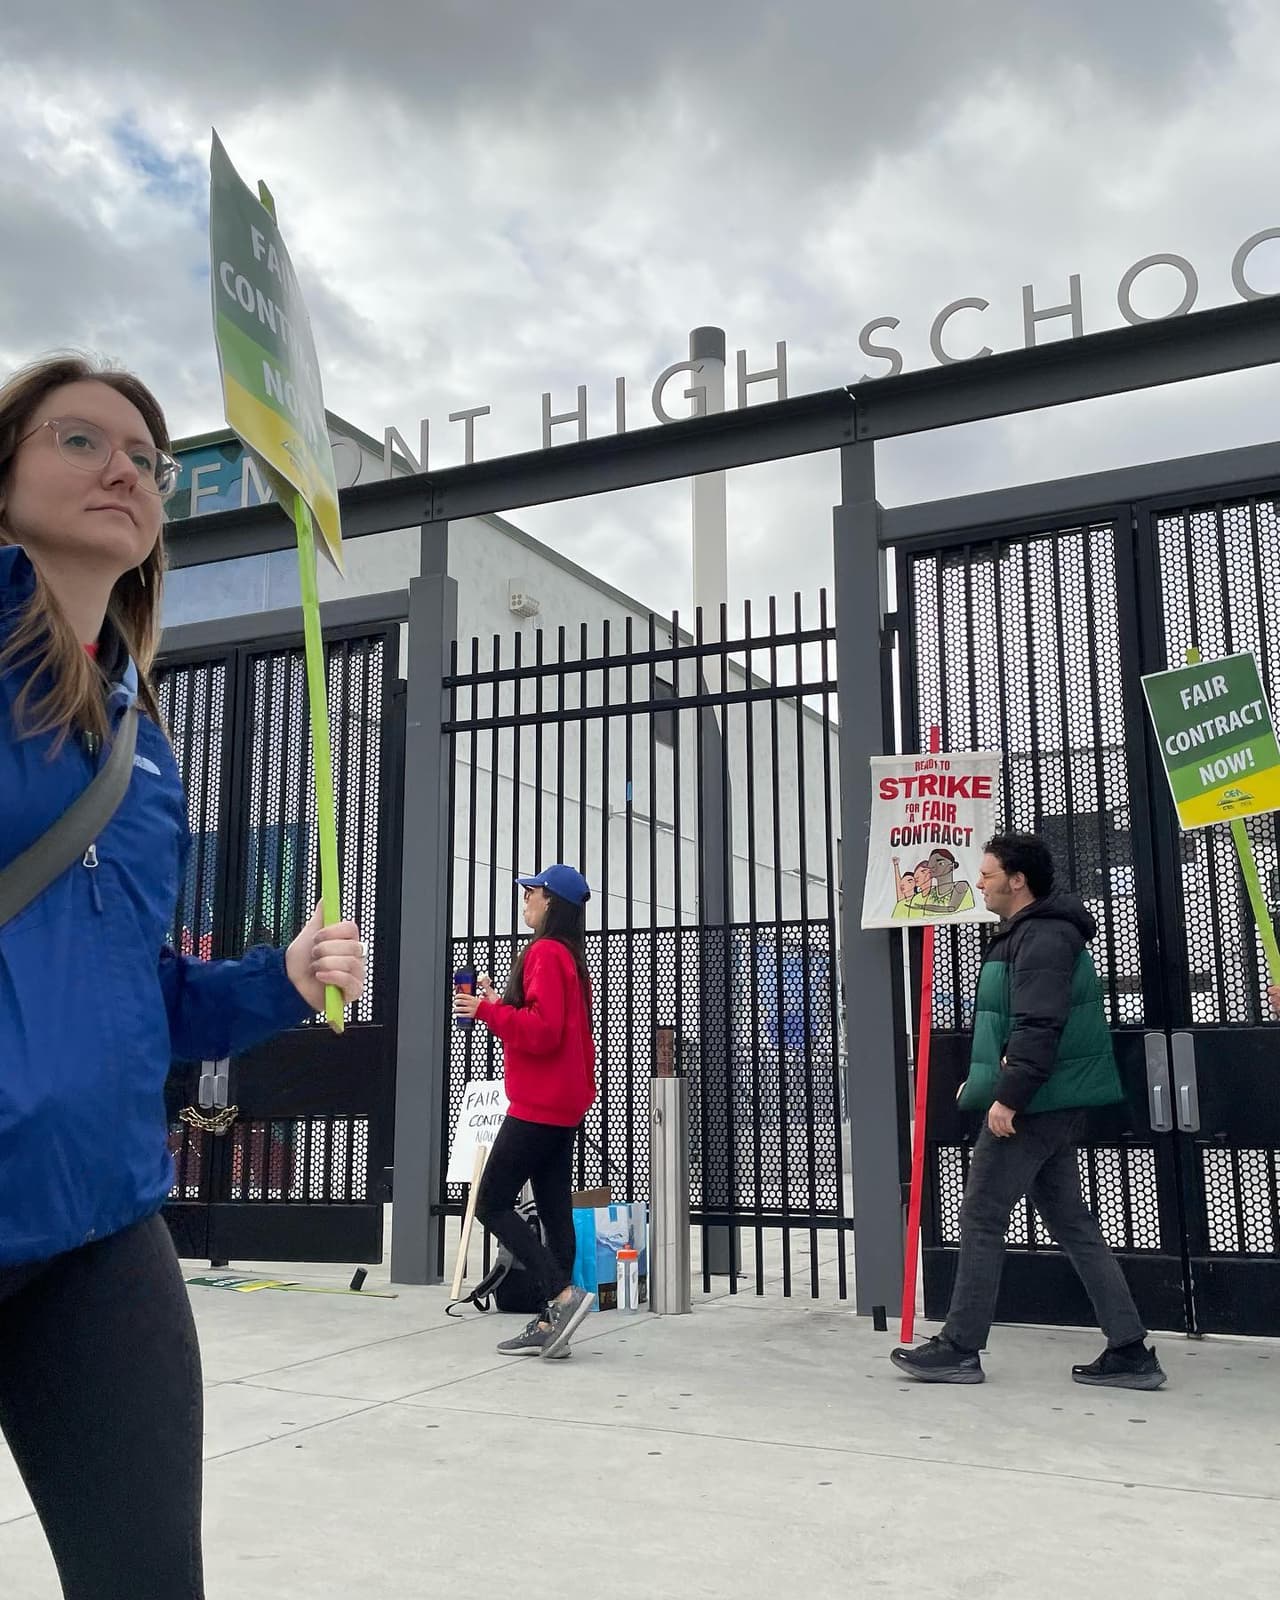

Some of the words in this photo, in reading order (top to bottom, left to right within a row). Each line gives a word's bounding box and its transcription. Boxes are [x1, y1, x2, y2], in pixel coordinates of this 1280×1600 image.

[541, 341, 787, 449] HIGH
[1180, 675, 1229, 711] FAIR
[1165, 699, 1263, 756] CONTRACT
[914, 758, 937, 772] READY
[939, 760, 950, 771] TO
[1199, 747, 1256, 786] NOW!
[879, 774, 992, 800] STRIKE
[905, 803, 919, 814] FOR
[909, 814, 915, 823] A
[922, 801, 957, 823] FAIR
[890, 823, 973, 848] CONTRACT
[466, 1090, 500, 1111] FAIR
